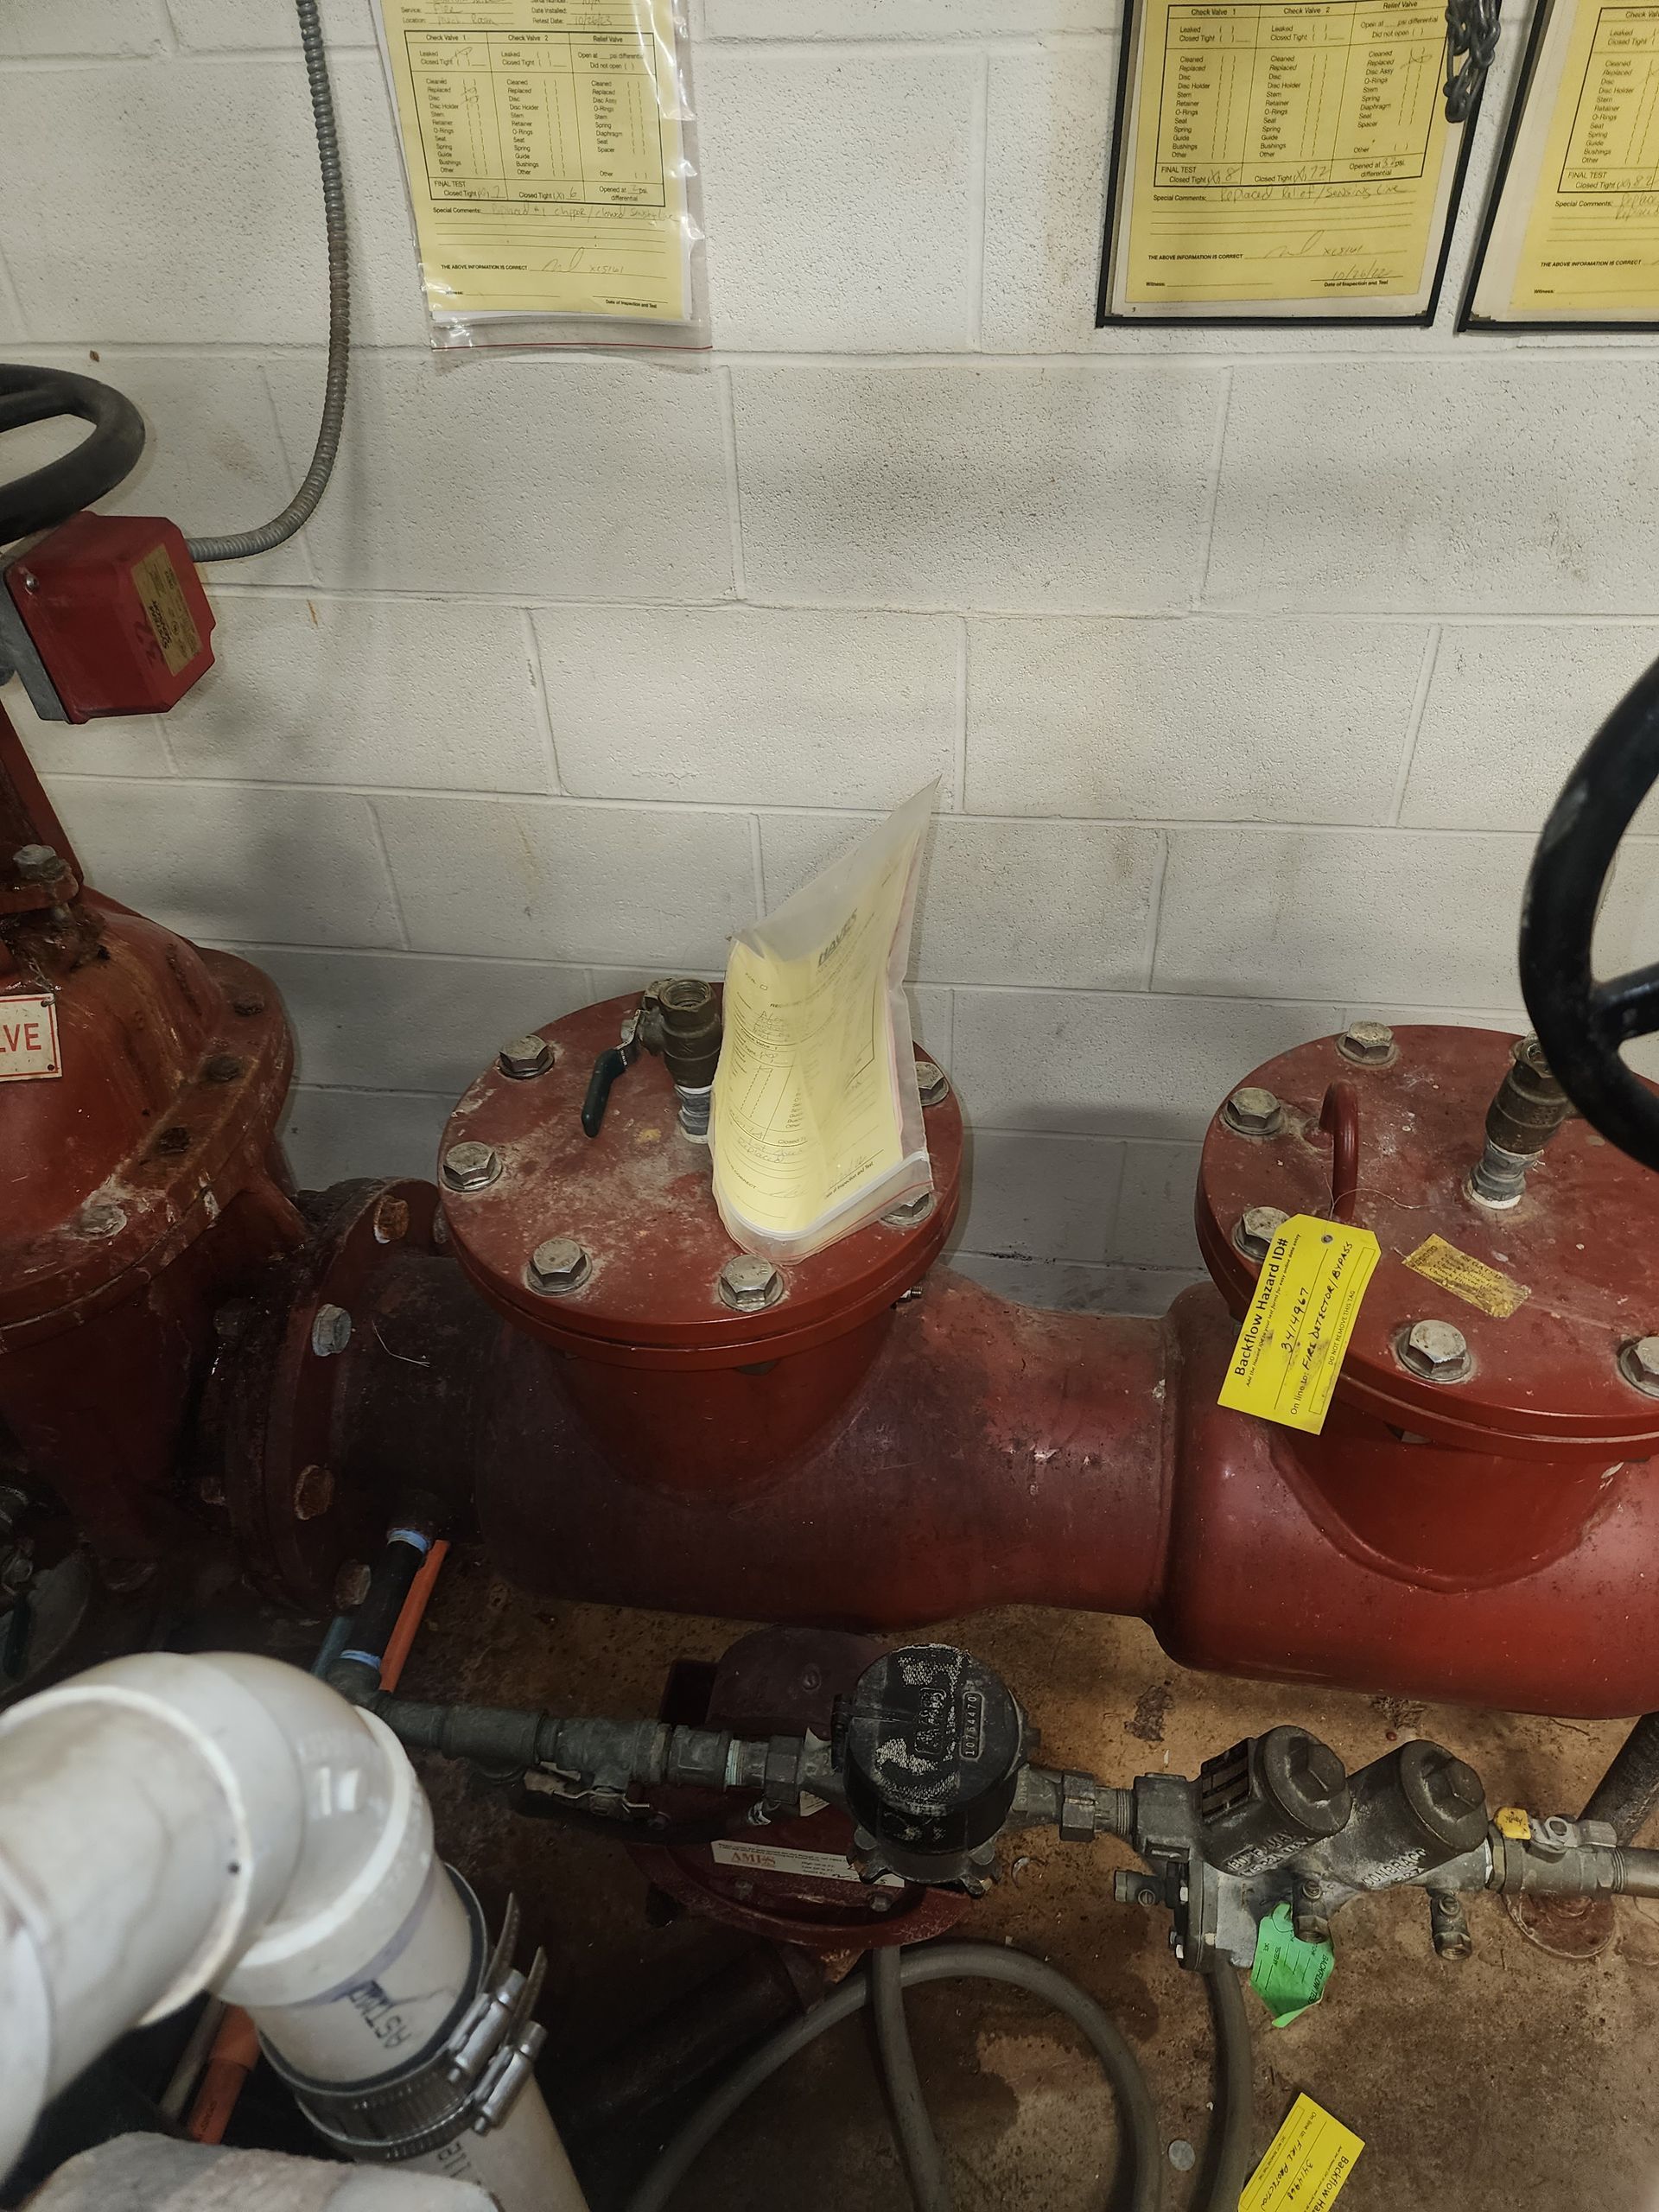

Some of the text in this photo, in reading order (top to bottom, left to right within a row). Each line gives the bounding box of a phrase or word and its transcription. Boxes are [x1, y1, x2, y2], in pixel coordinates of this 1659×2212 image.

[1282, 1258, 1292, 1274] online
[1235, 1238, 1289, 1376] Backflow Hazard ID#
[1327, 1290, 1356, 1366] DO NOT REMOVE THIS TAG
[1303, 1343, 1317, 1370] FIRE
[1294, 1384, 1306, 1402] line
[1290, 1402, 1300, 1415] On
[732, 1853, 776, 1866] AMES
[1316, 1954, 1329, 1988] BACKFLOW
[1321, 2155, 1350, 2198] Backflow
